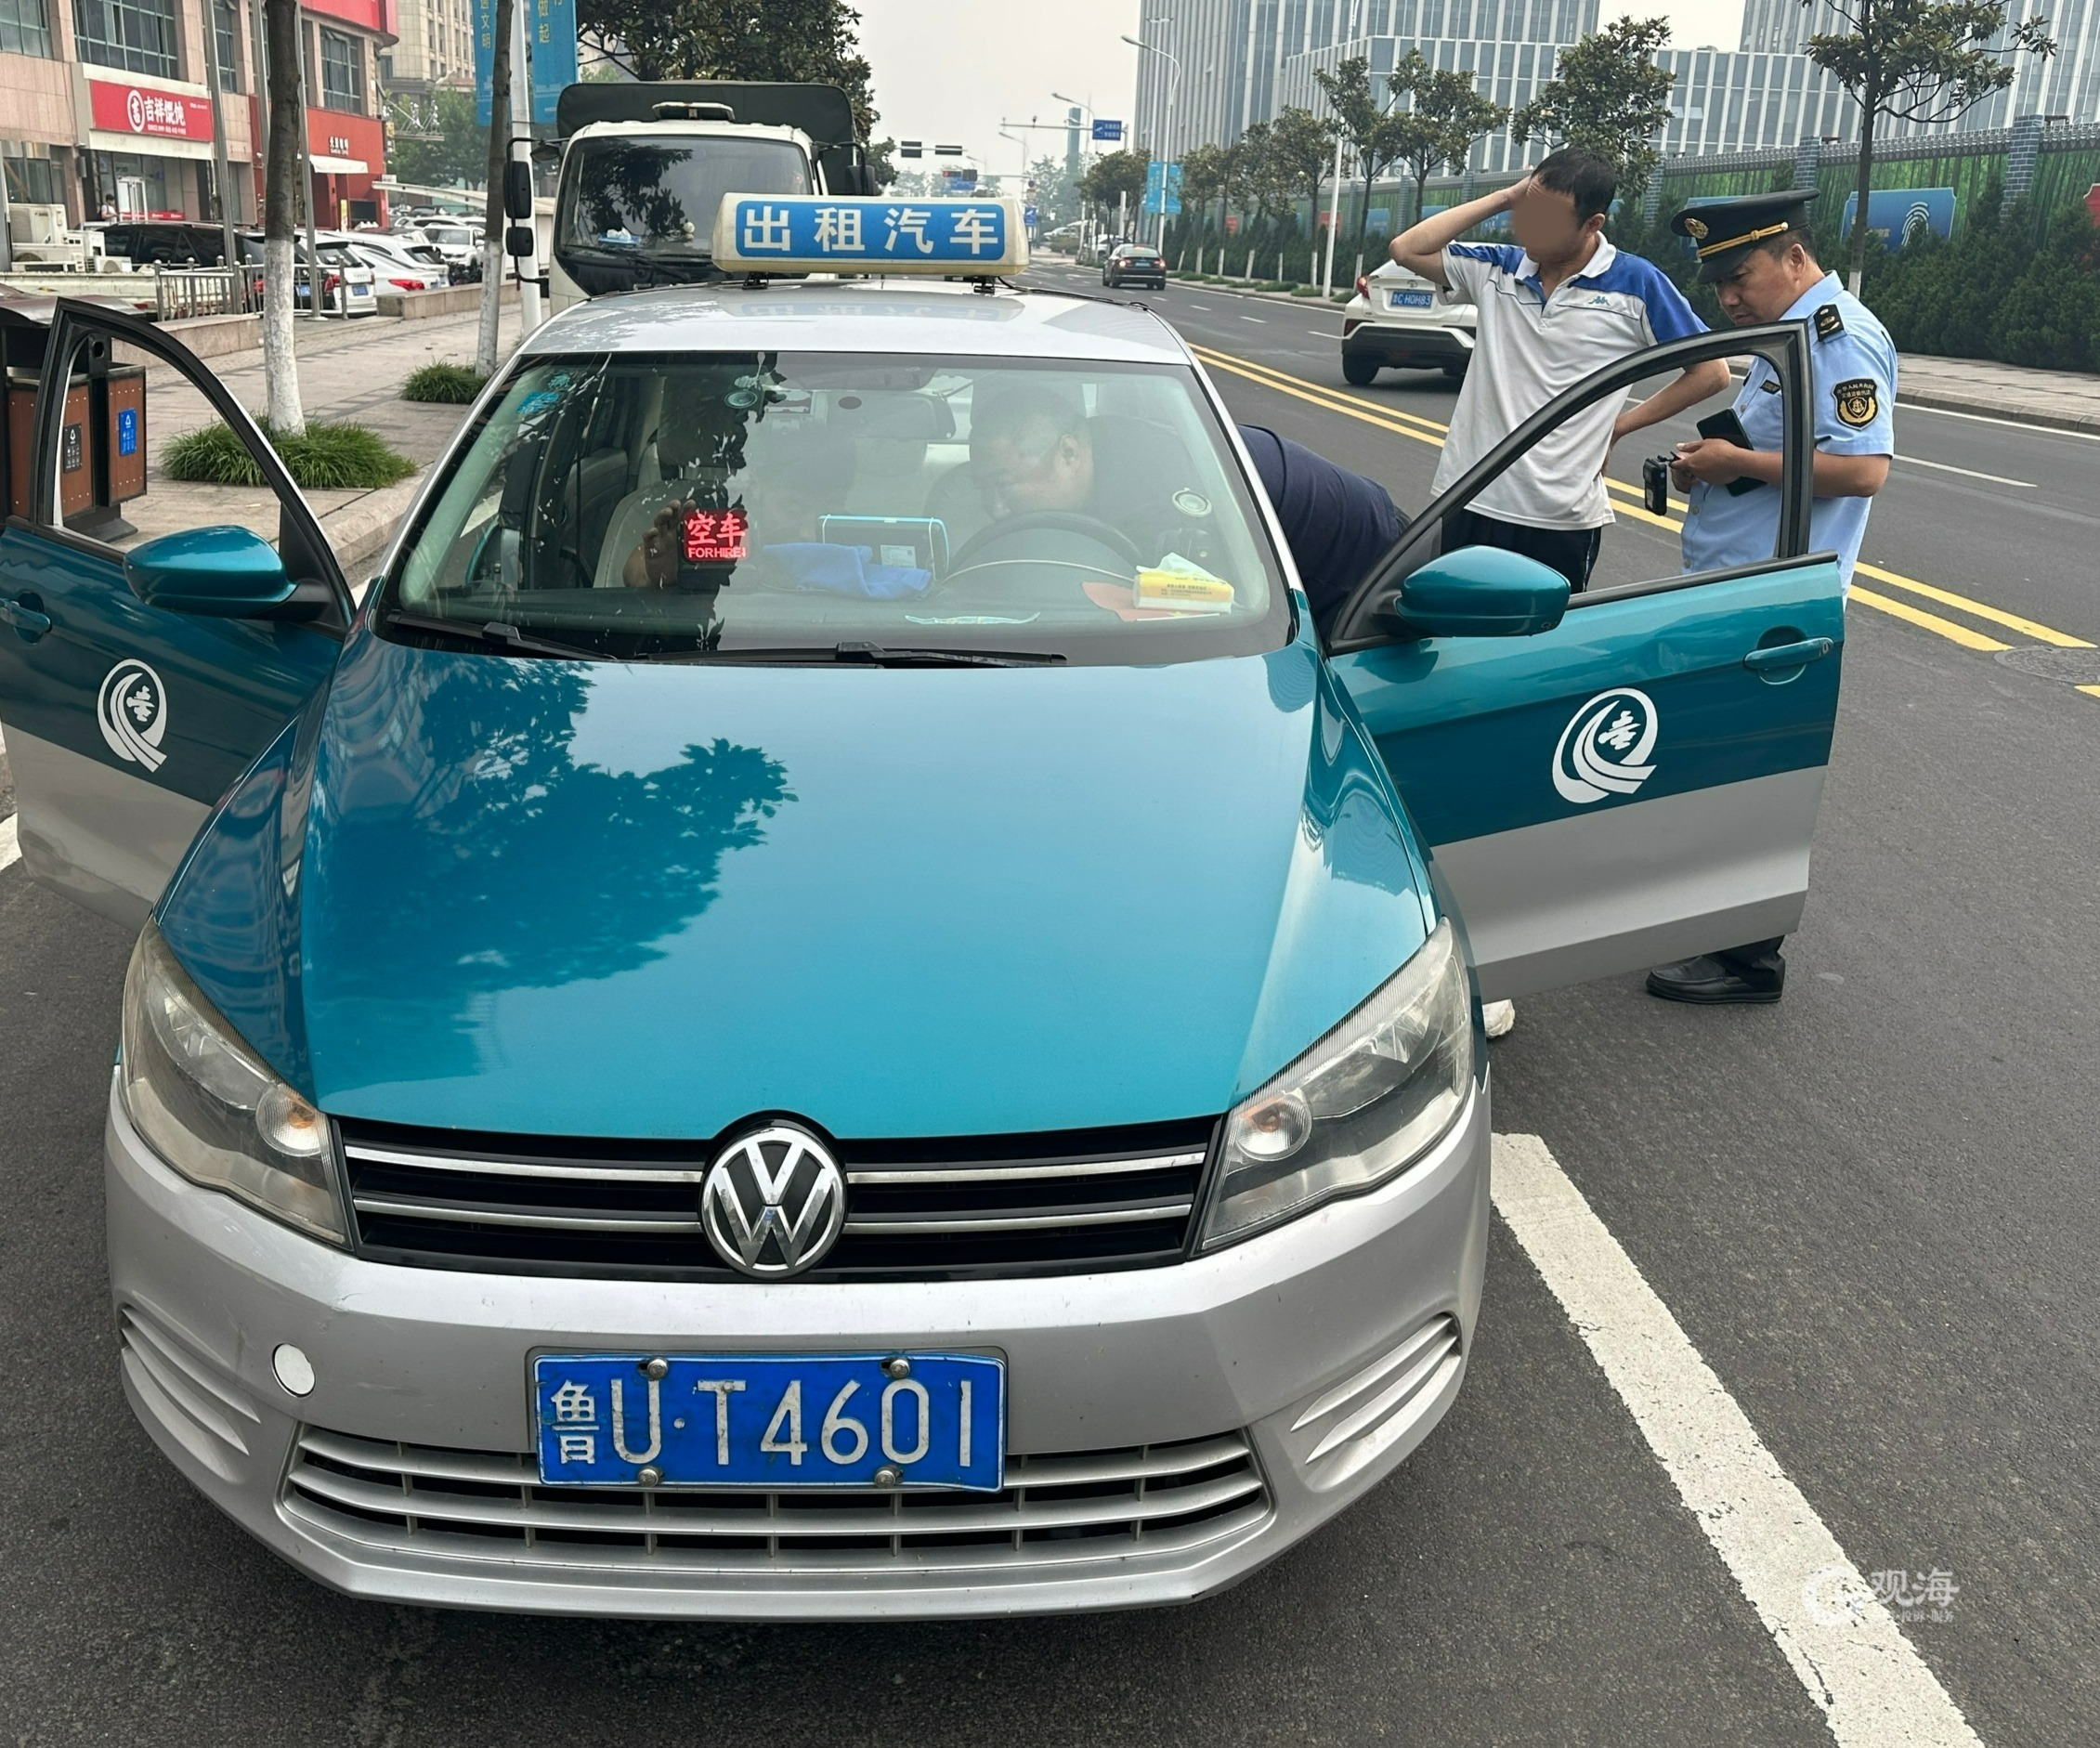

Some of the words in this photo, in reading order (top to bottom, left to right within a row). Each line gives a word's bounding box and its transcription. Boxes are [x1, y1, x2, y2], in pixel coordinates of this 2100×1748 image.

[144, 96, 186, 125] 吉祥馄饨
[744, 205, 998, 254] 出租汽车
[687, 512, 746, 547] 空车
[551, 1378, 972, 1468] 鲁U·T4601
